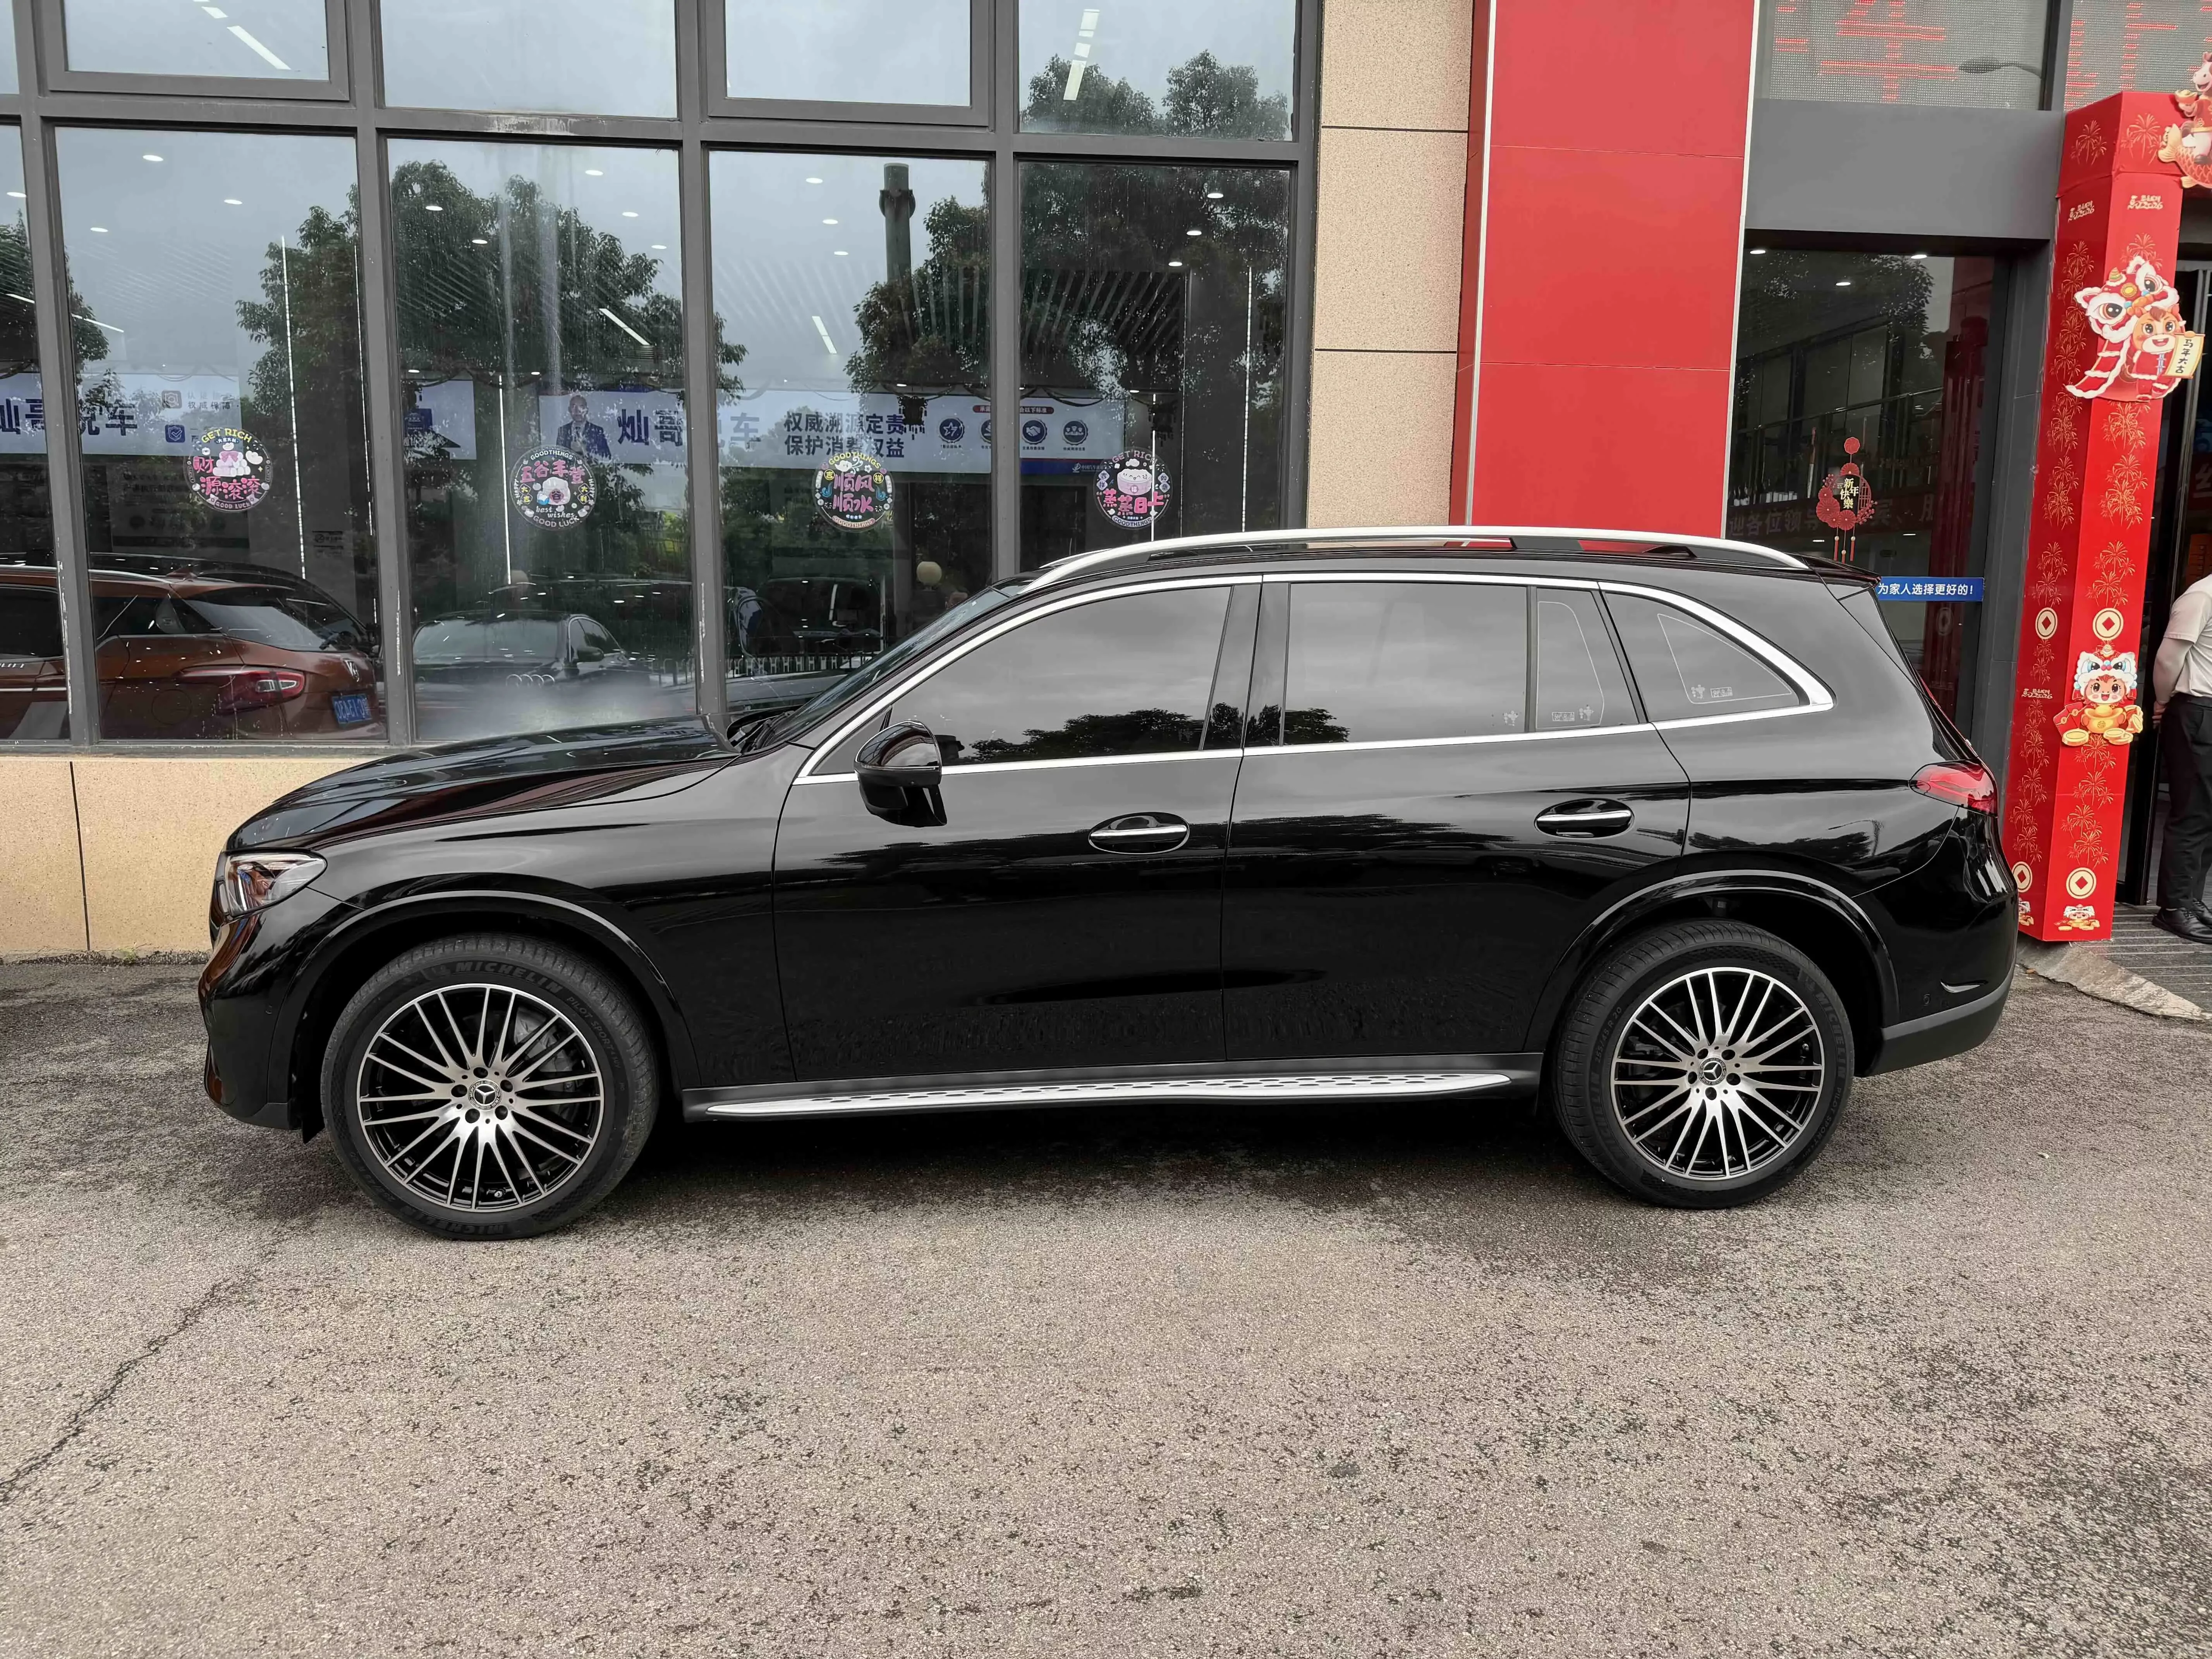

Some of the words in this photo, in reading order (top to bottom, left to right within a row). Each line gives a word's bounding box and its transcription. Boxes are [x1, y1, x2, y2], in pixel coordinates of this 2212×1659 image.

[2176, 339, 2193, 373] 马年大吉
[784, 412, 905, 434] 权威溯源定责
[201, 428, 221, 443] GET
[225, 428, 252, 443] RICH
[785, 435, 905, 458] 保护消费权益
[193, 456, 214, 473] 财
[829, 452, 851, 465] GOOD
[851, 452, 881, 469] THINGS
[1112, 451, 1130, 463] GET
[1134, 450, 1157, 465] RICH
[520, 459, 585, 484] 五谷丰登
[833, 472, 875, 492] 顺风
[200, 475, 262, 500] 源滚滚
[551, 490, 562, 500] 谷
[833, 492, 874, 513] 顺水
[1103, 488, 1164, 515] 蒸蒸日上
[533, 515, 556, 527] GOOD
[559, 515, 579, 527] LUCK
[455, 962, 563, 994] MICHELIN
[566, 996, 593, 1018] PILOT
[591, 1021, 614, 1050] SPORT
[1607, 1020, 1614, 1029] R
[1613, 1006, 1622, 1020] 20
[1815, 992, 1846, 1079] MICHELIN
[1830, 1087, 1842, 1114] PILOT
